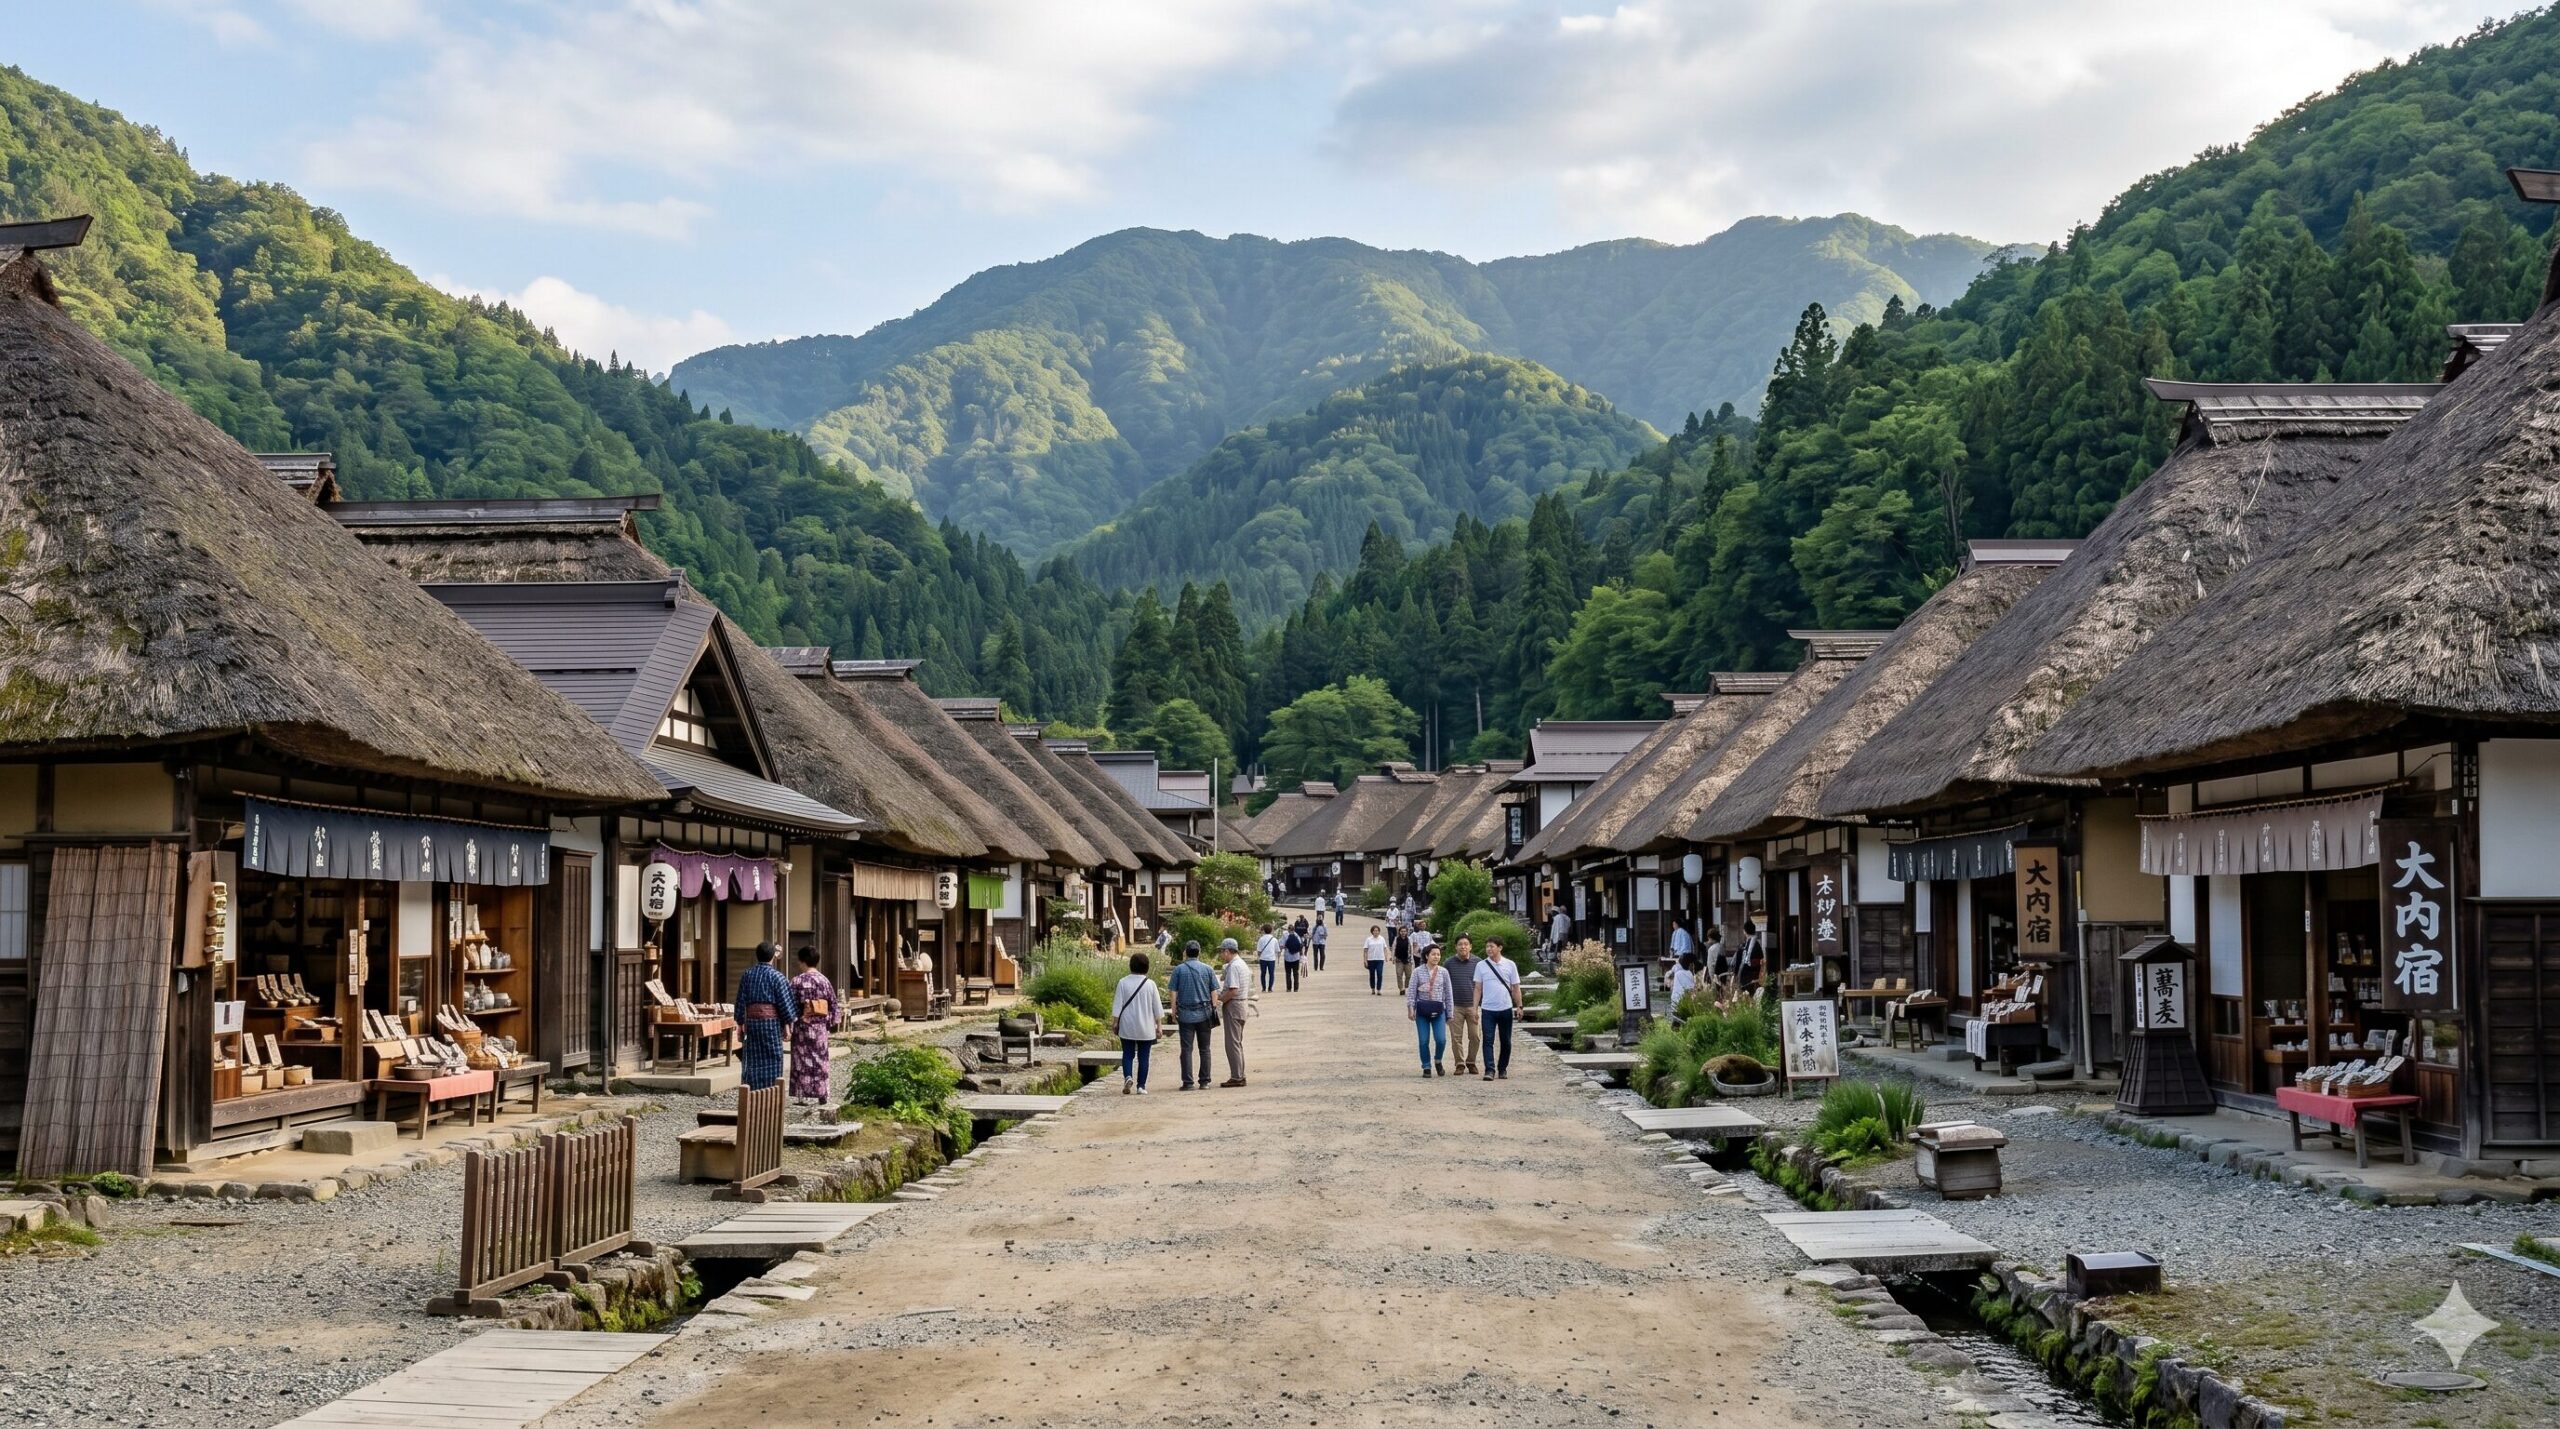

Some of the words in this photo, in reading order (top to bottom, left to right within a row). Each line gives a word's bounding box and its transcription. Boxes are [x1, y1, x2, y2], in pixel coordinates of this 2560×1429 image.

[2024, 859, 2052, 943] 大内宿
[2393, 841, 2445, 995] 大内宿
